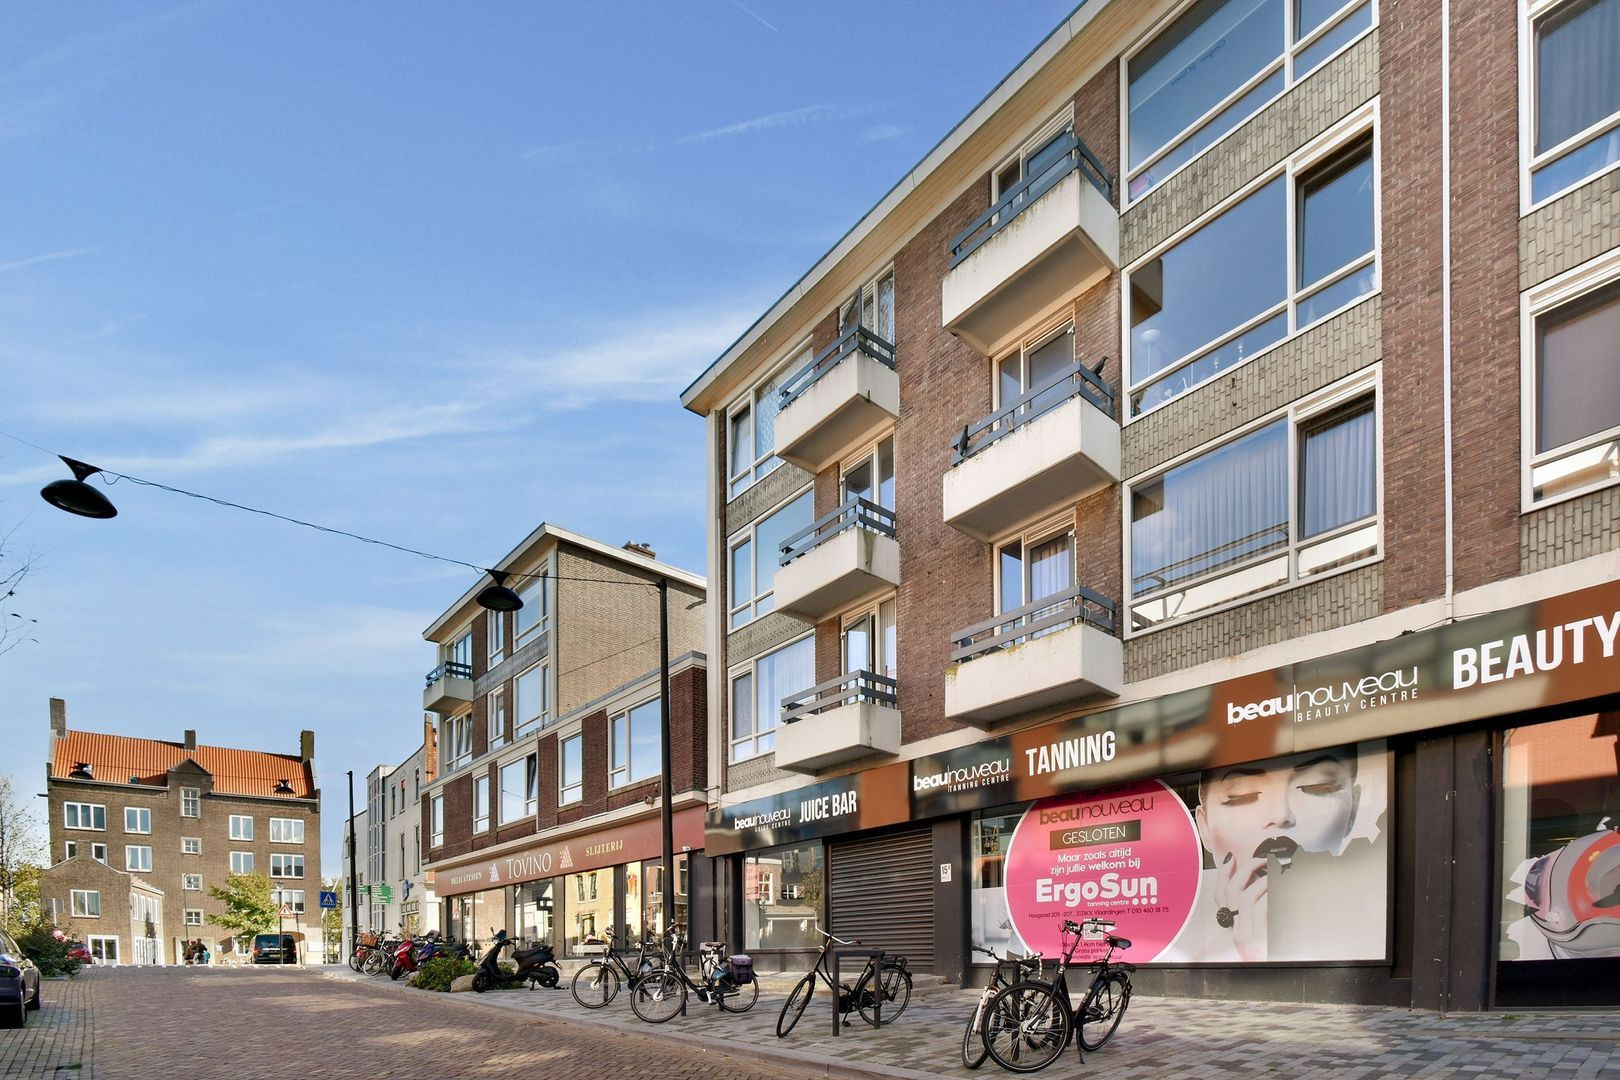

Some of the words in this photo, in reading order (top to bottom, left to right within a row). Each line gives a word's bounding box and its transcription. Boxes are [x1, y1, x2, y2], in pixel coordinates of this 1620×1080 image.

[1453, 610, 1620, 690] BEAUTY
[1297, 703, 1351, 723] BEAUTY
[1360, 688, 1418, 710] CENTRE
[1025, 730, 1116, 777] TANNING
[949, 779, 978, 793] TANNING
[981, 774, 1009, 786] CENTRE
[798, 796, 830, 823] JUICE
[832, 790, 857, 817] BAR
[1062, 825, 1126, 845] GESLOTEN
[585, 840, 623, 856] SLIJTERIJ
[1057, 853, 1081, 863] Maar
[1083, 850, 1107, 861] zoals
[1109, 847, 1132, 859] altijd
[506, 852, 552, 879] TOVINO
[1050, 865, 1065, 876] zijn
[1065, 863, 1086, 875] jullie
[1088, 858, 1126, 871] welkom
[1128, 857, 1141, 869] bij
[451, 871, 482, 886] DELICATESSEN
[1036, 872, 1158, 907] ErgoSun
[1087, 899, 1110, 908] tanning
[1110, 899, 1129, 907] centre
